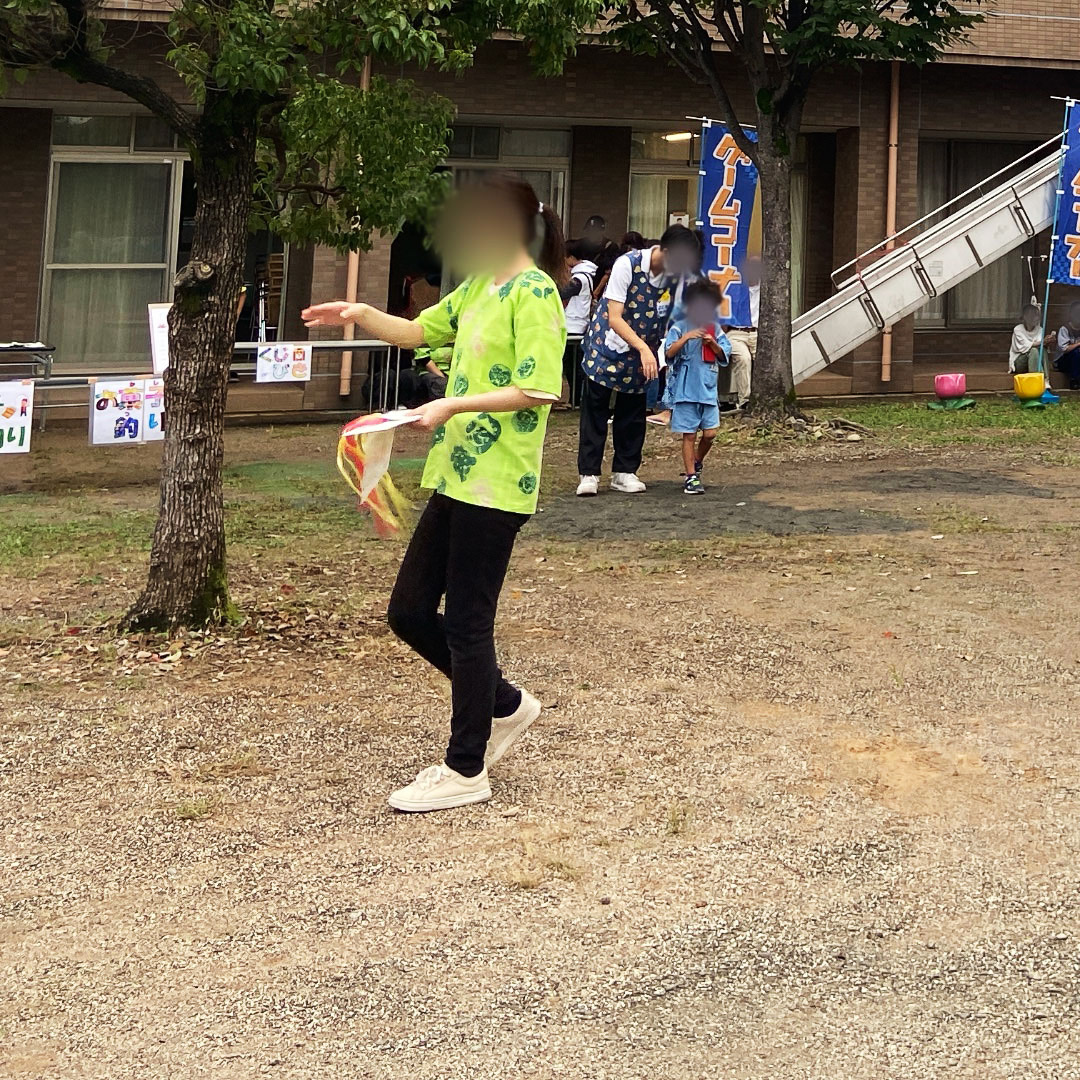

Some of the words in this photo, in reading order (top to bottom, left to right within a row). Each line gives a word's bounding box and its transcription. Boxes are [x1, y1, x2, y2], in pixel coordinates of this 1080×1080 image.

[708, 133, 751, 319] ゲームコーナー
